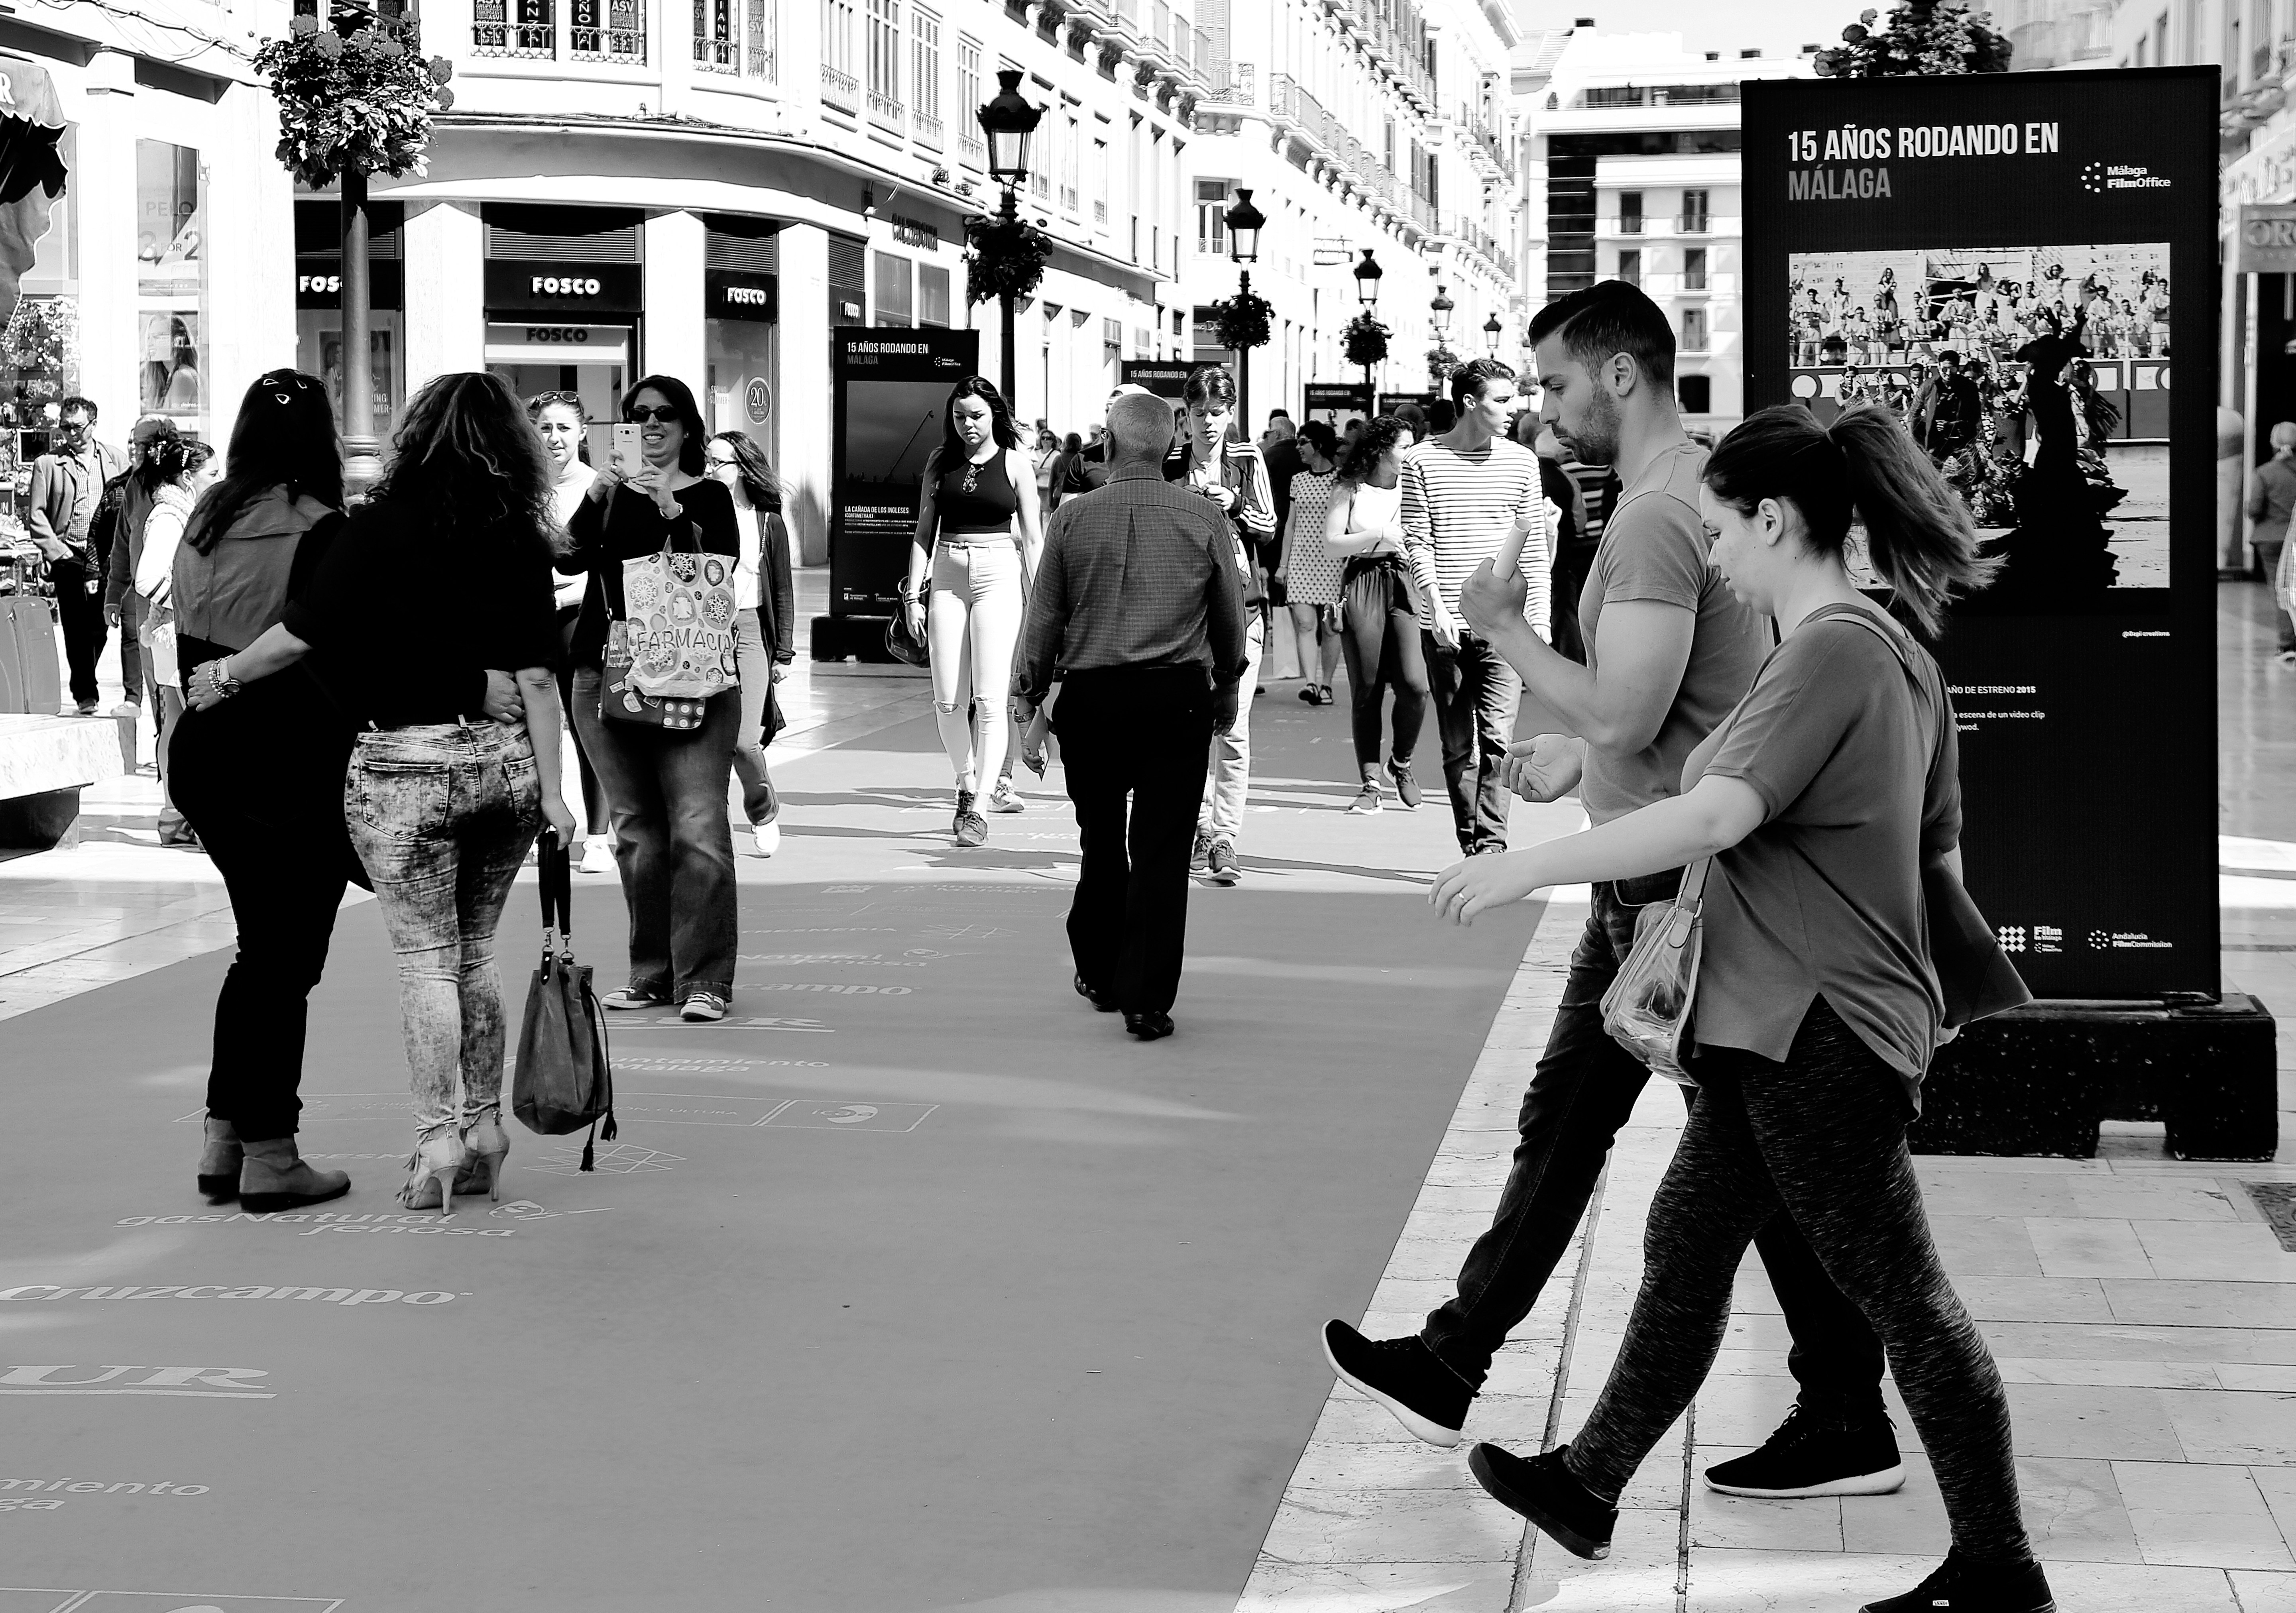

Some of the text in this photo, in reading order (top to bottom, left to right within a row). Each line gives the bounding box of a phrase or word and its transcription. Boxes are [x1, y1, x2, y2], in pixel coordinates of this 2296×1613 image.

[611, 0, 634, 12] ASV
[1789, 122, 2058, 161] 15 AÑOS RODANDO EN
[2107, 165, 2147, 177] Málaga
[1789, 164, 1891, 200] MÁLAGA
[2107, 177, 2171, 188] FilmOffice
[299, 275, 342, 293] FOS
[532, 277, 601, 295] FOSCO
[727, 287, 767, 305] FOSCO
[526, 327, 588, 342] FOSCO
[847, 341, 928, 354] 15 AÑOS RODANDO EN
[2030, 711, 2045, 719] clip
[2034, 925, 2062, 935] Film
[298, 1223, 516, 1237] fenosa
[0, 1285, 456, 1306] Cruzcampo
